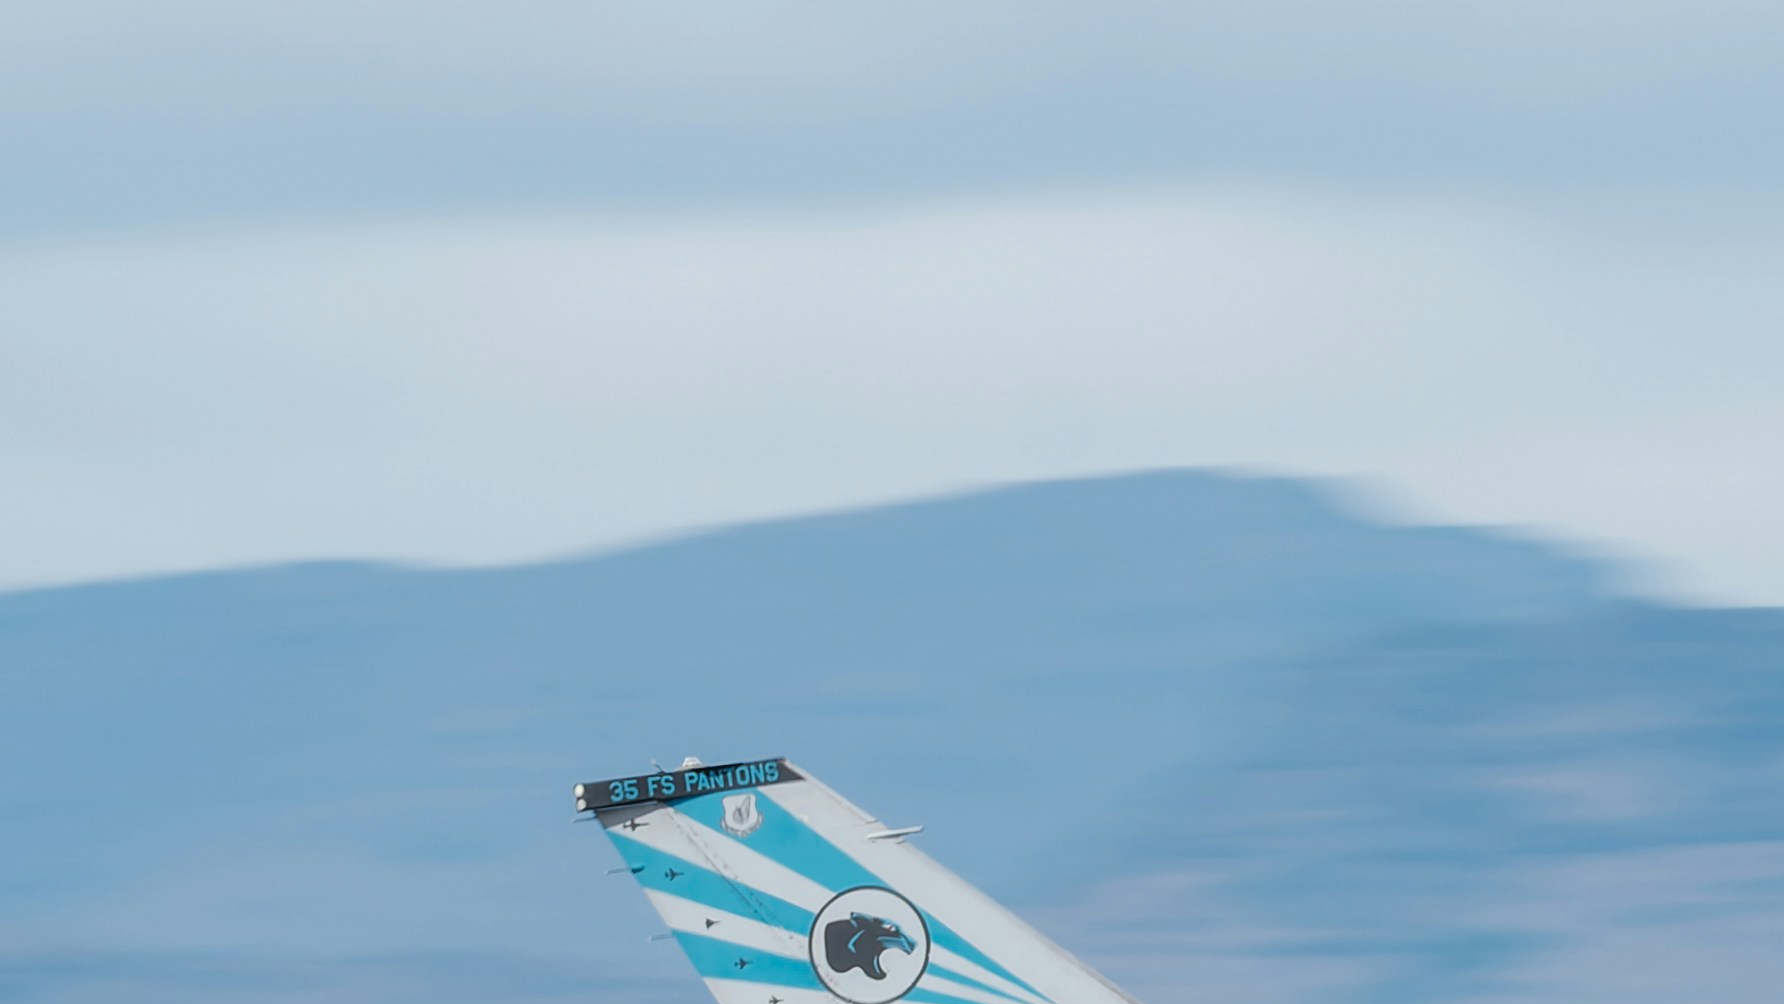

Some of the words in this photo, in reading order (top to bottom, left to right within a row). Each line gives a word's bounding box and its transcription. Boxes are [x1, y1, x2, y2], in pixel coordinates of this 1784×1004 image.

[609, 779, 639, 802] 35
[646, 775, 675, 797] FS
[684, 761, 779, 792] PANTONS
